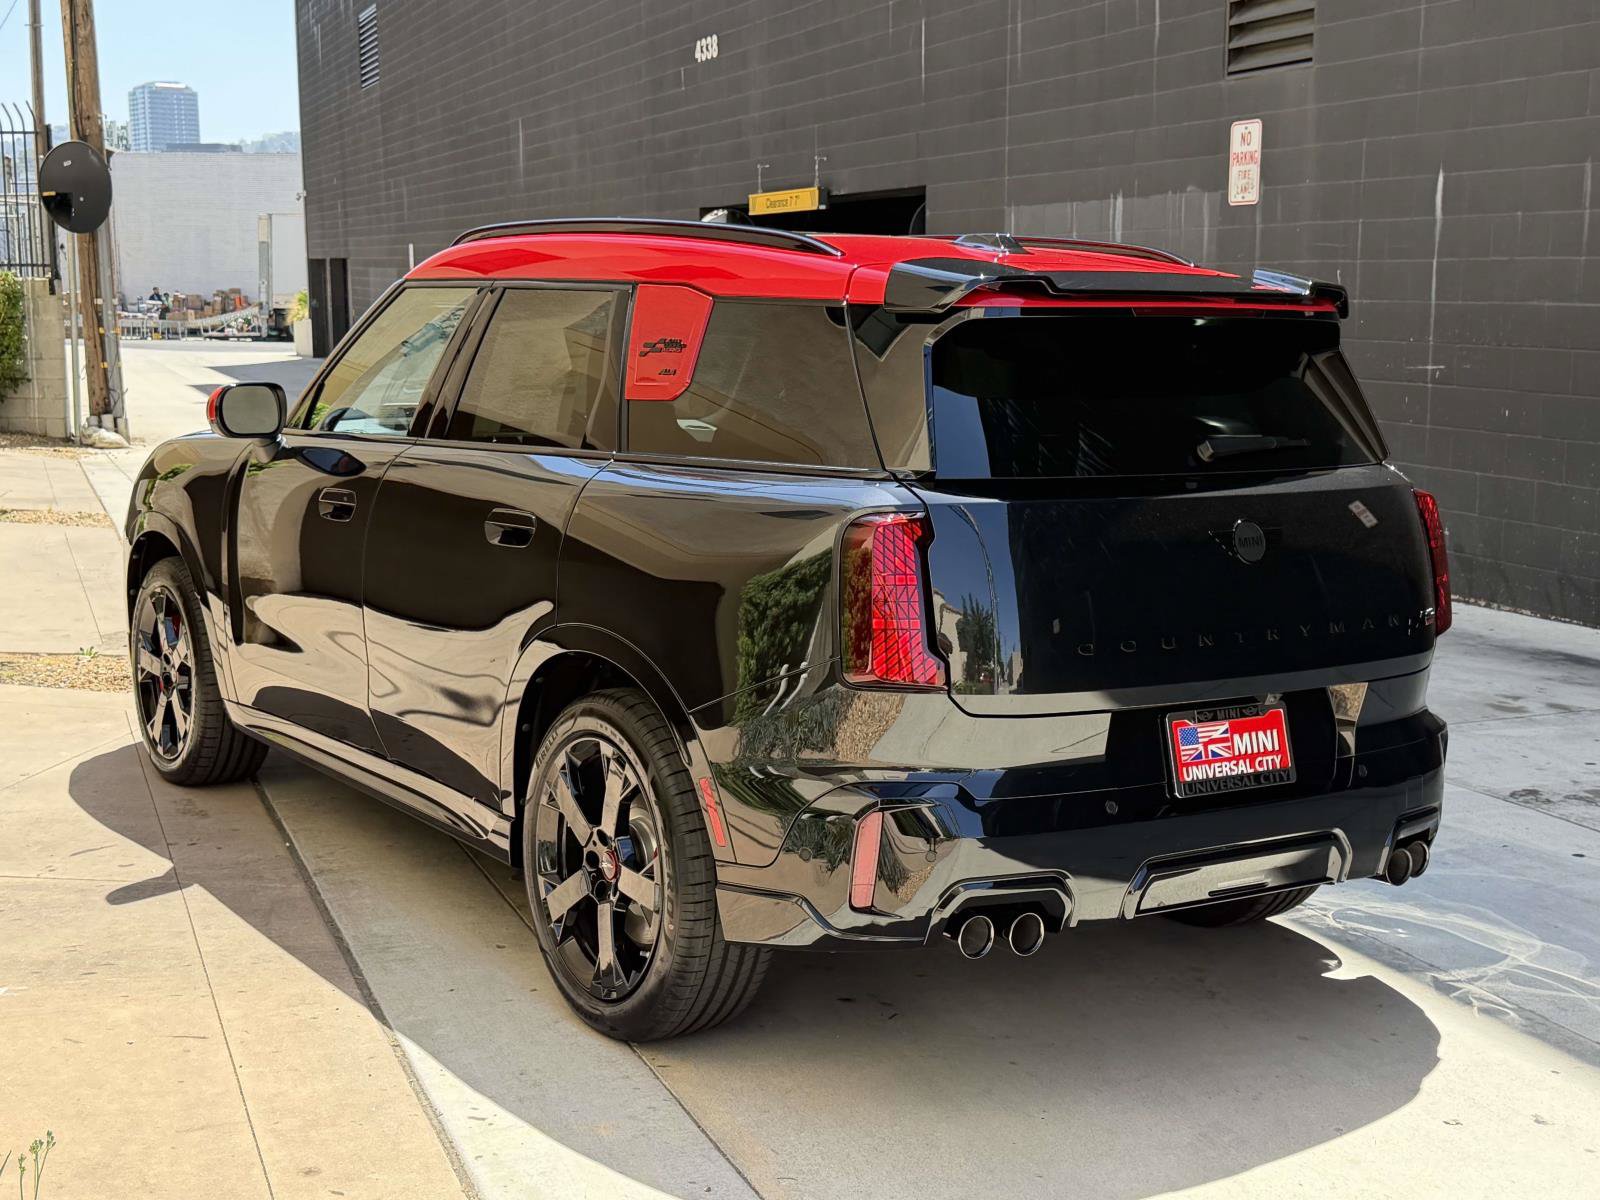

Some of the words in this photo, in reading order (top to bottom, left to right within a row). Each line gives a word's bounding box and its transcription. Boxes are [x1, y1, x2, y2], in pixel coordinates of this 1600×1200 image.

[694, 33, 719, 63] 4338
[1240, 131, 1252, 147] NO
[1232, 150, 1258, 167] PARKING
[1238, 535, 1263, 547] MINI
[1077, 614, 1400, 656] COUNTRYMAN
[1216, 707, 1240, 719] MINI
[1233, 728, 1280, 756] MINI
[1182, 760, 1255, 782] UNIVERSAL
[1255, 754, 1282, 772] CITY
[1184, 774, 1258, 796] UNIVERSAL
[1260, 770, 1290, 784] CITY
